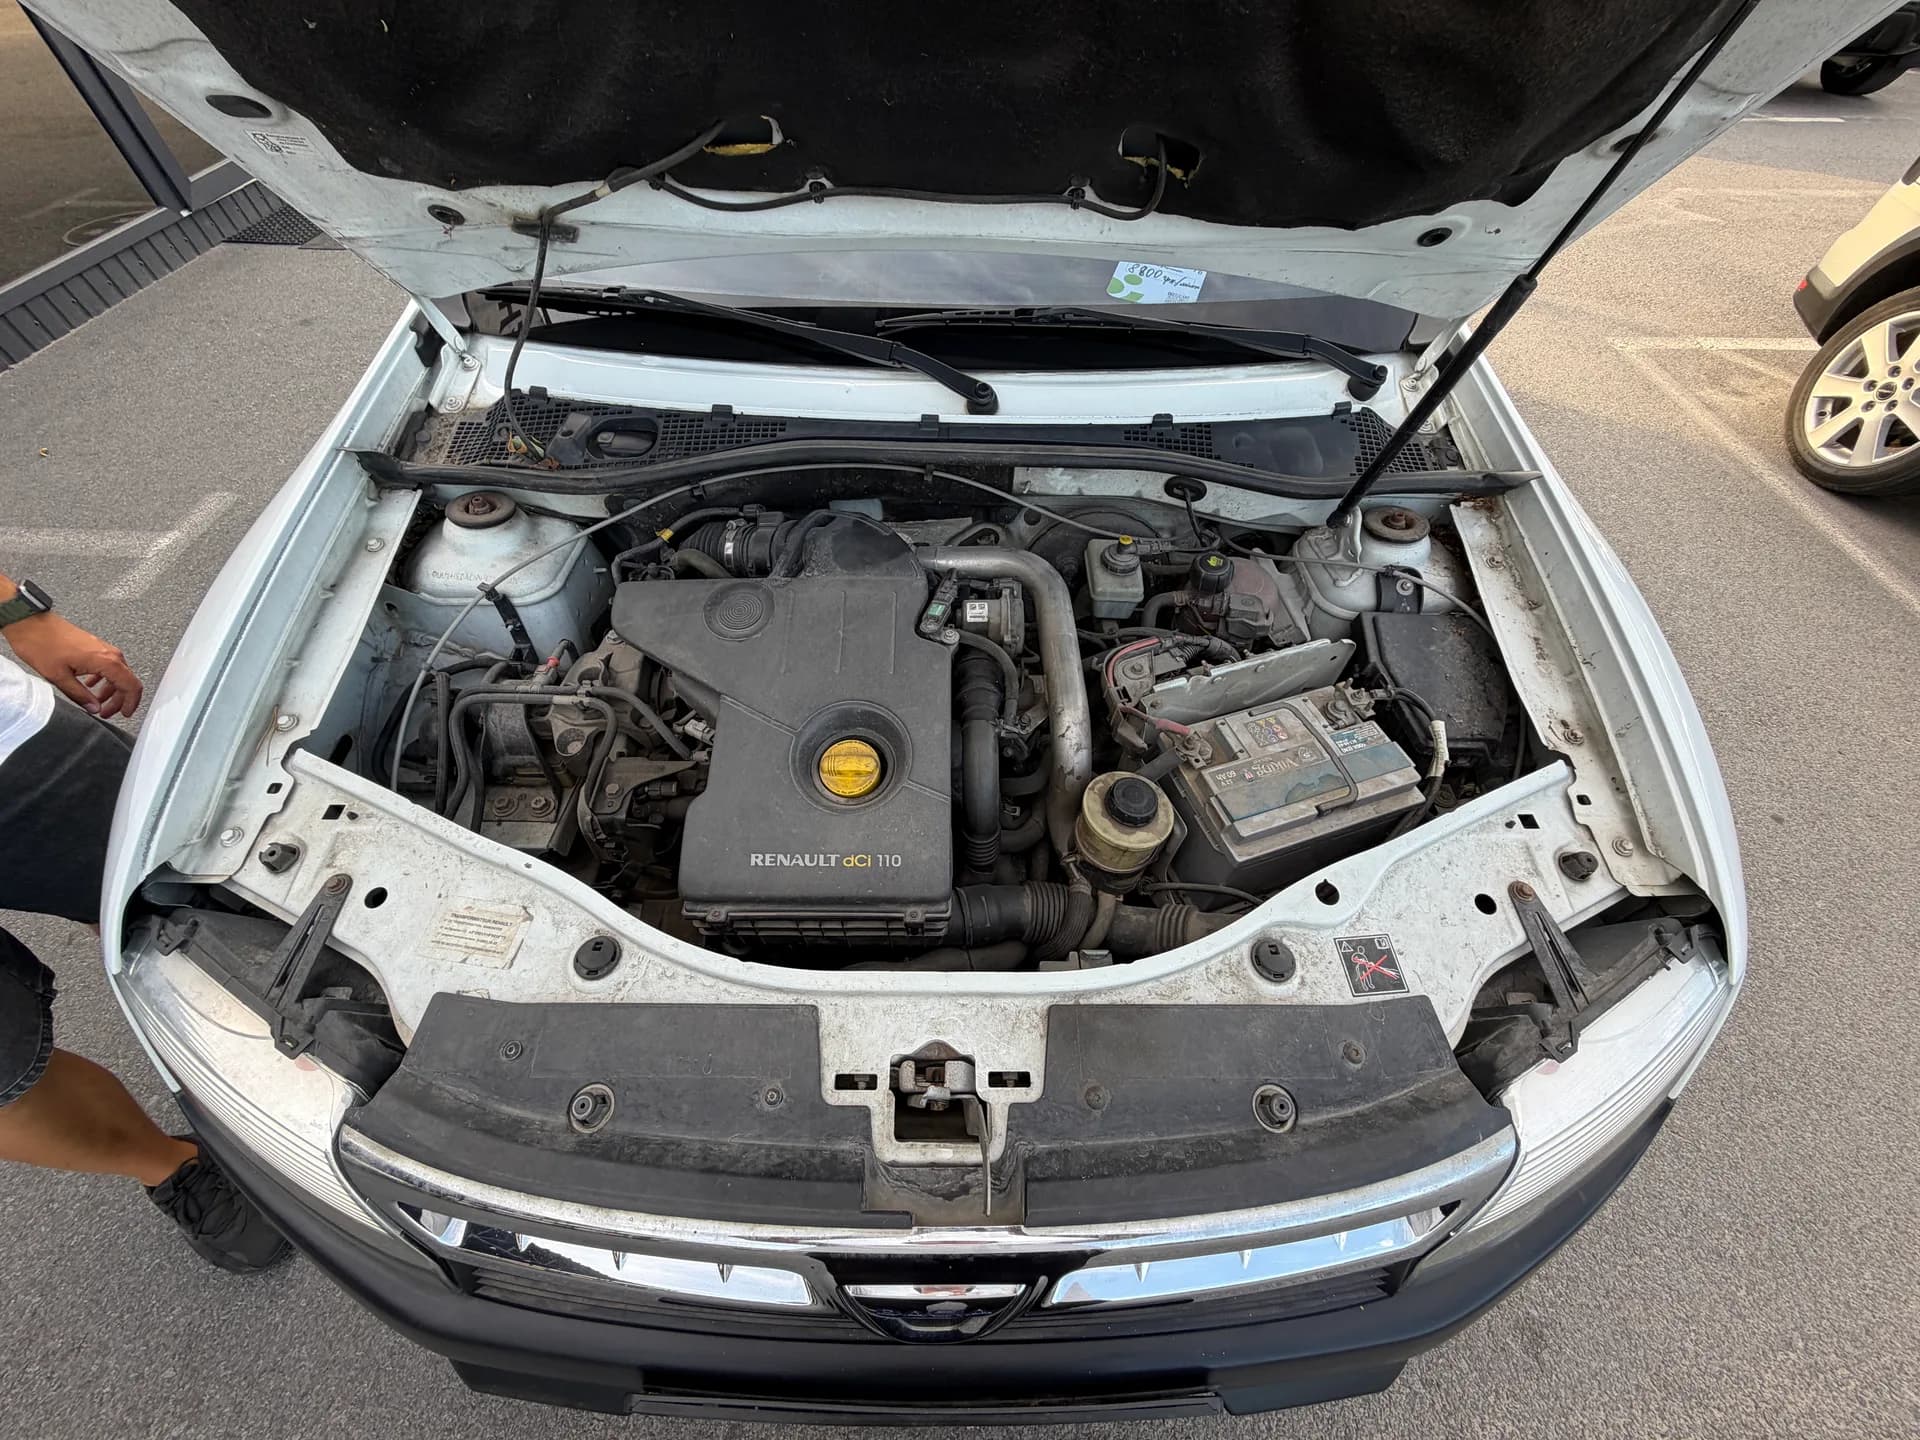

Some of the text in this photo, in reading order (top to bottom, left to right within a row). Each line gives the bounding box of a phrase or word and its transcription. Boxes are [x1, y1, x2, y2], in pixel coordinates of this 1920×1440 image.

[1128, 263, 1163, 279] 8800
[750, 853, 902, 867] RENAULT dCi 110
